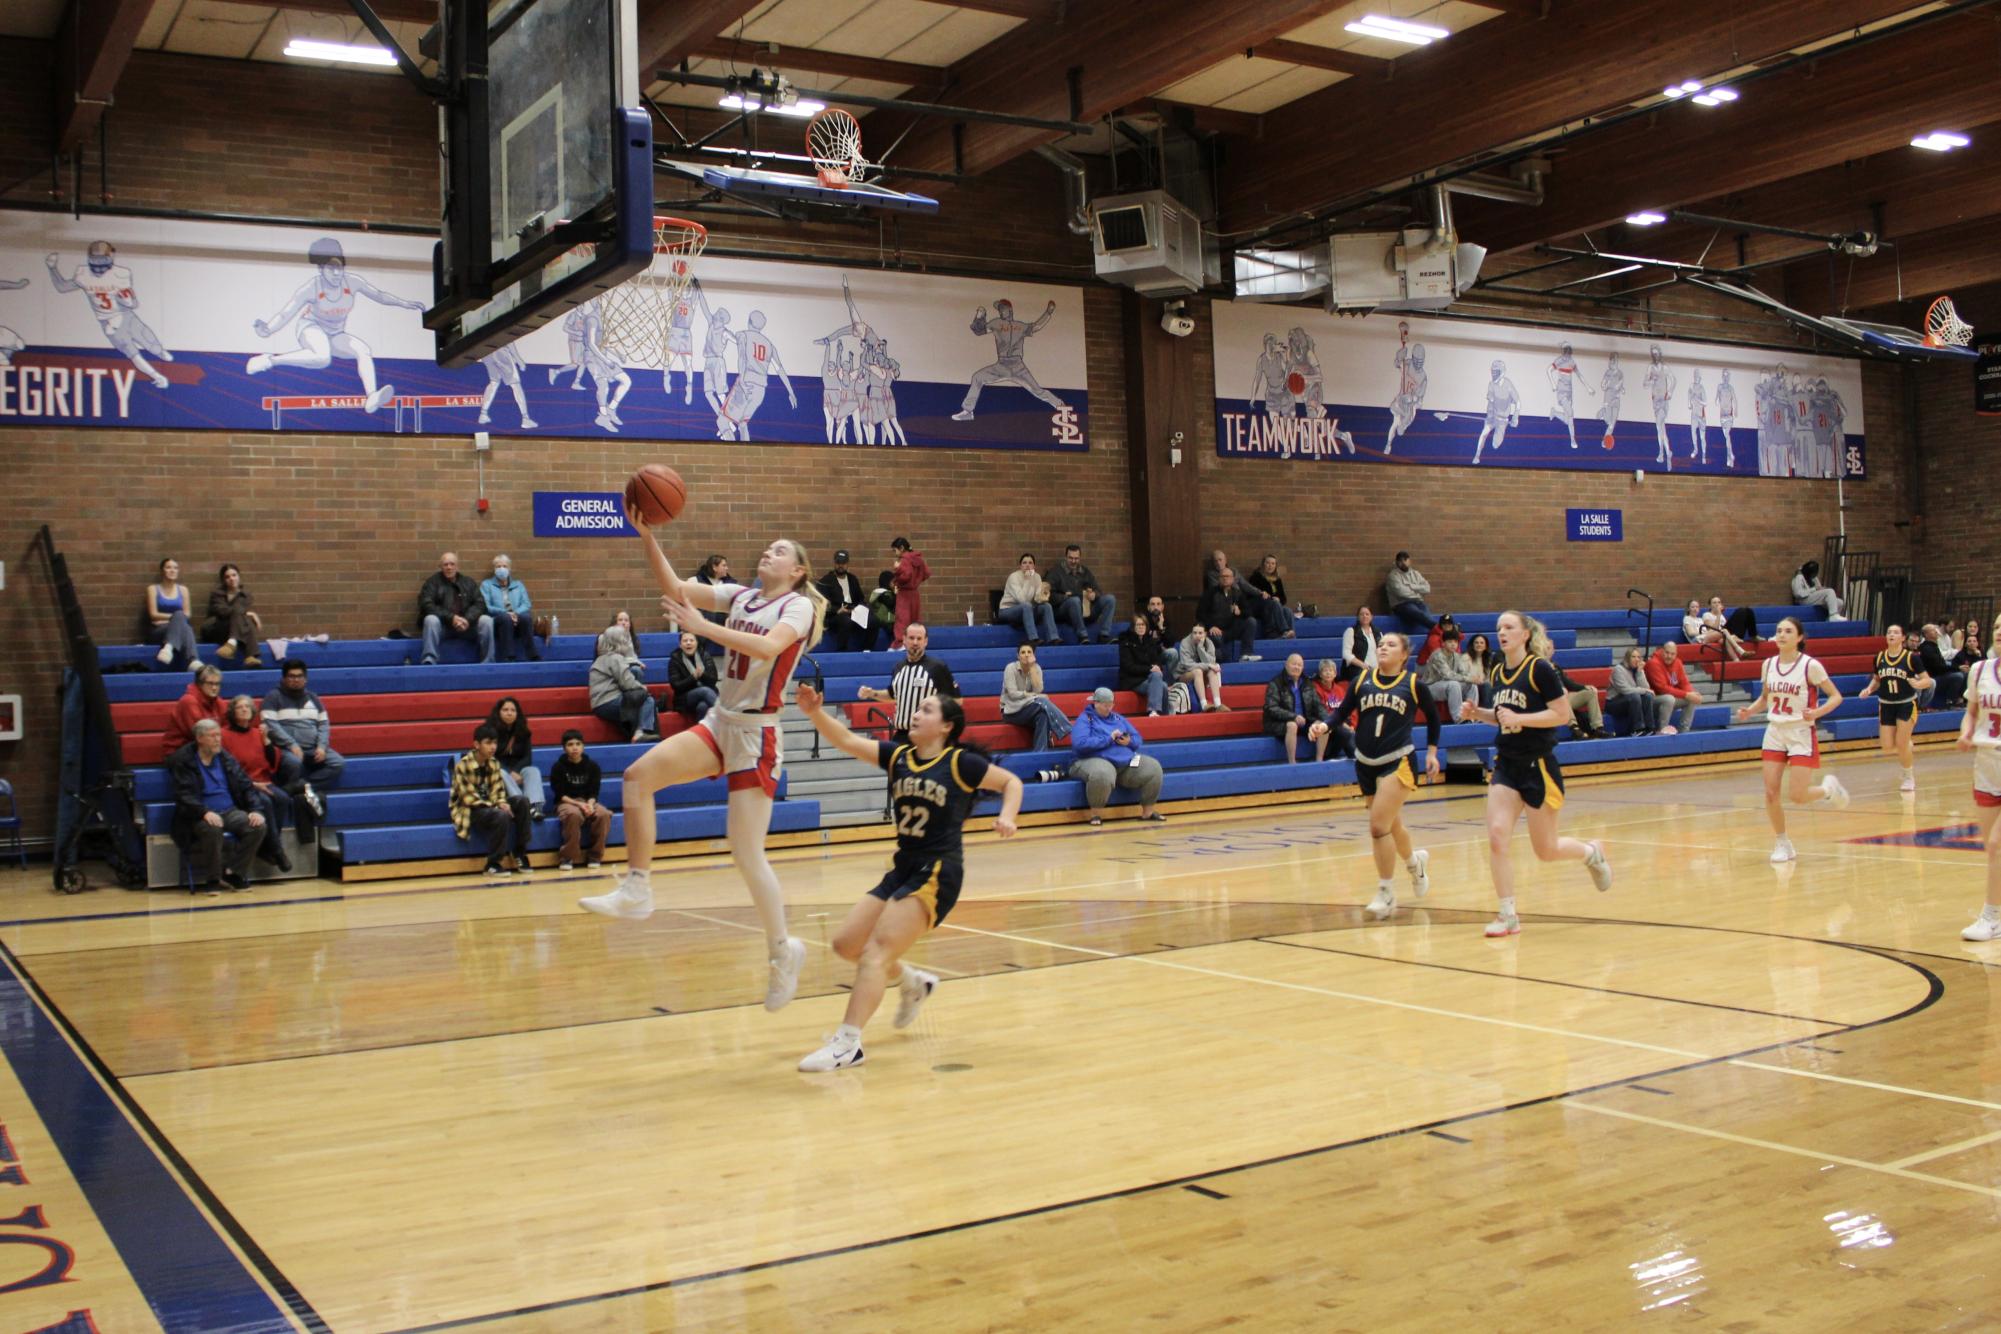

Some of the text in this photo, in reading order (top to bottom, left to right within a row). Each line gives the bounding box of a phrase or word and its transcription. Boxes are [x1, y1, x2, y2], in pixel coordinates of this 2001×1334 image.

[752, 341, 766, 362] 10
[311, 398, 327, 408] LA
[446, 397, 459, 407] LA
[1222, 412, 1341, 455] TEAMWORK
[561, 500, 617, 513] GENERAL
[555, 516, 624, 529] ADMISSION
[1581, 514, 1609, 524] LA SALLE
[1579, 525, 1612, 536] STUDENTS
[1887, 679, 1899, 694] 11
[1360, 693, 1407, 715] EAGLES
[1493, 688, 1527, 709] AGLES
[1375, 713, 1385, 738] 1
[899, 804, 930, 838] 22
